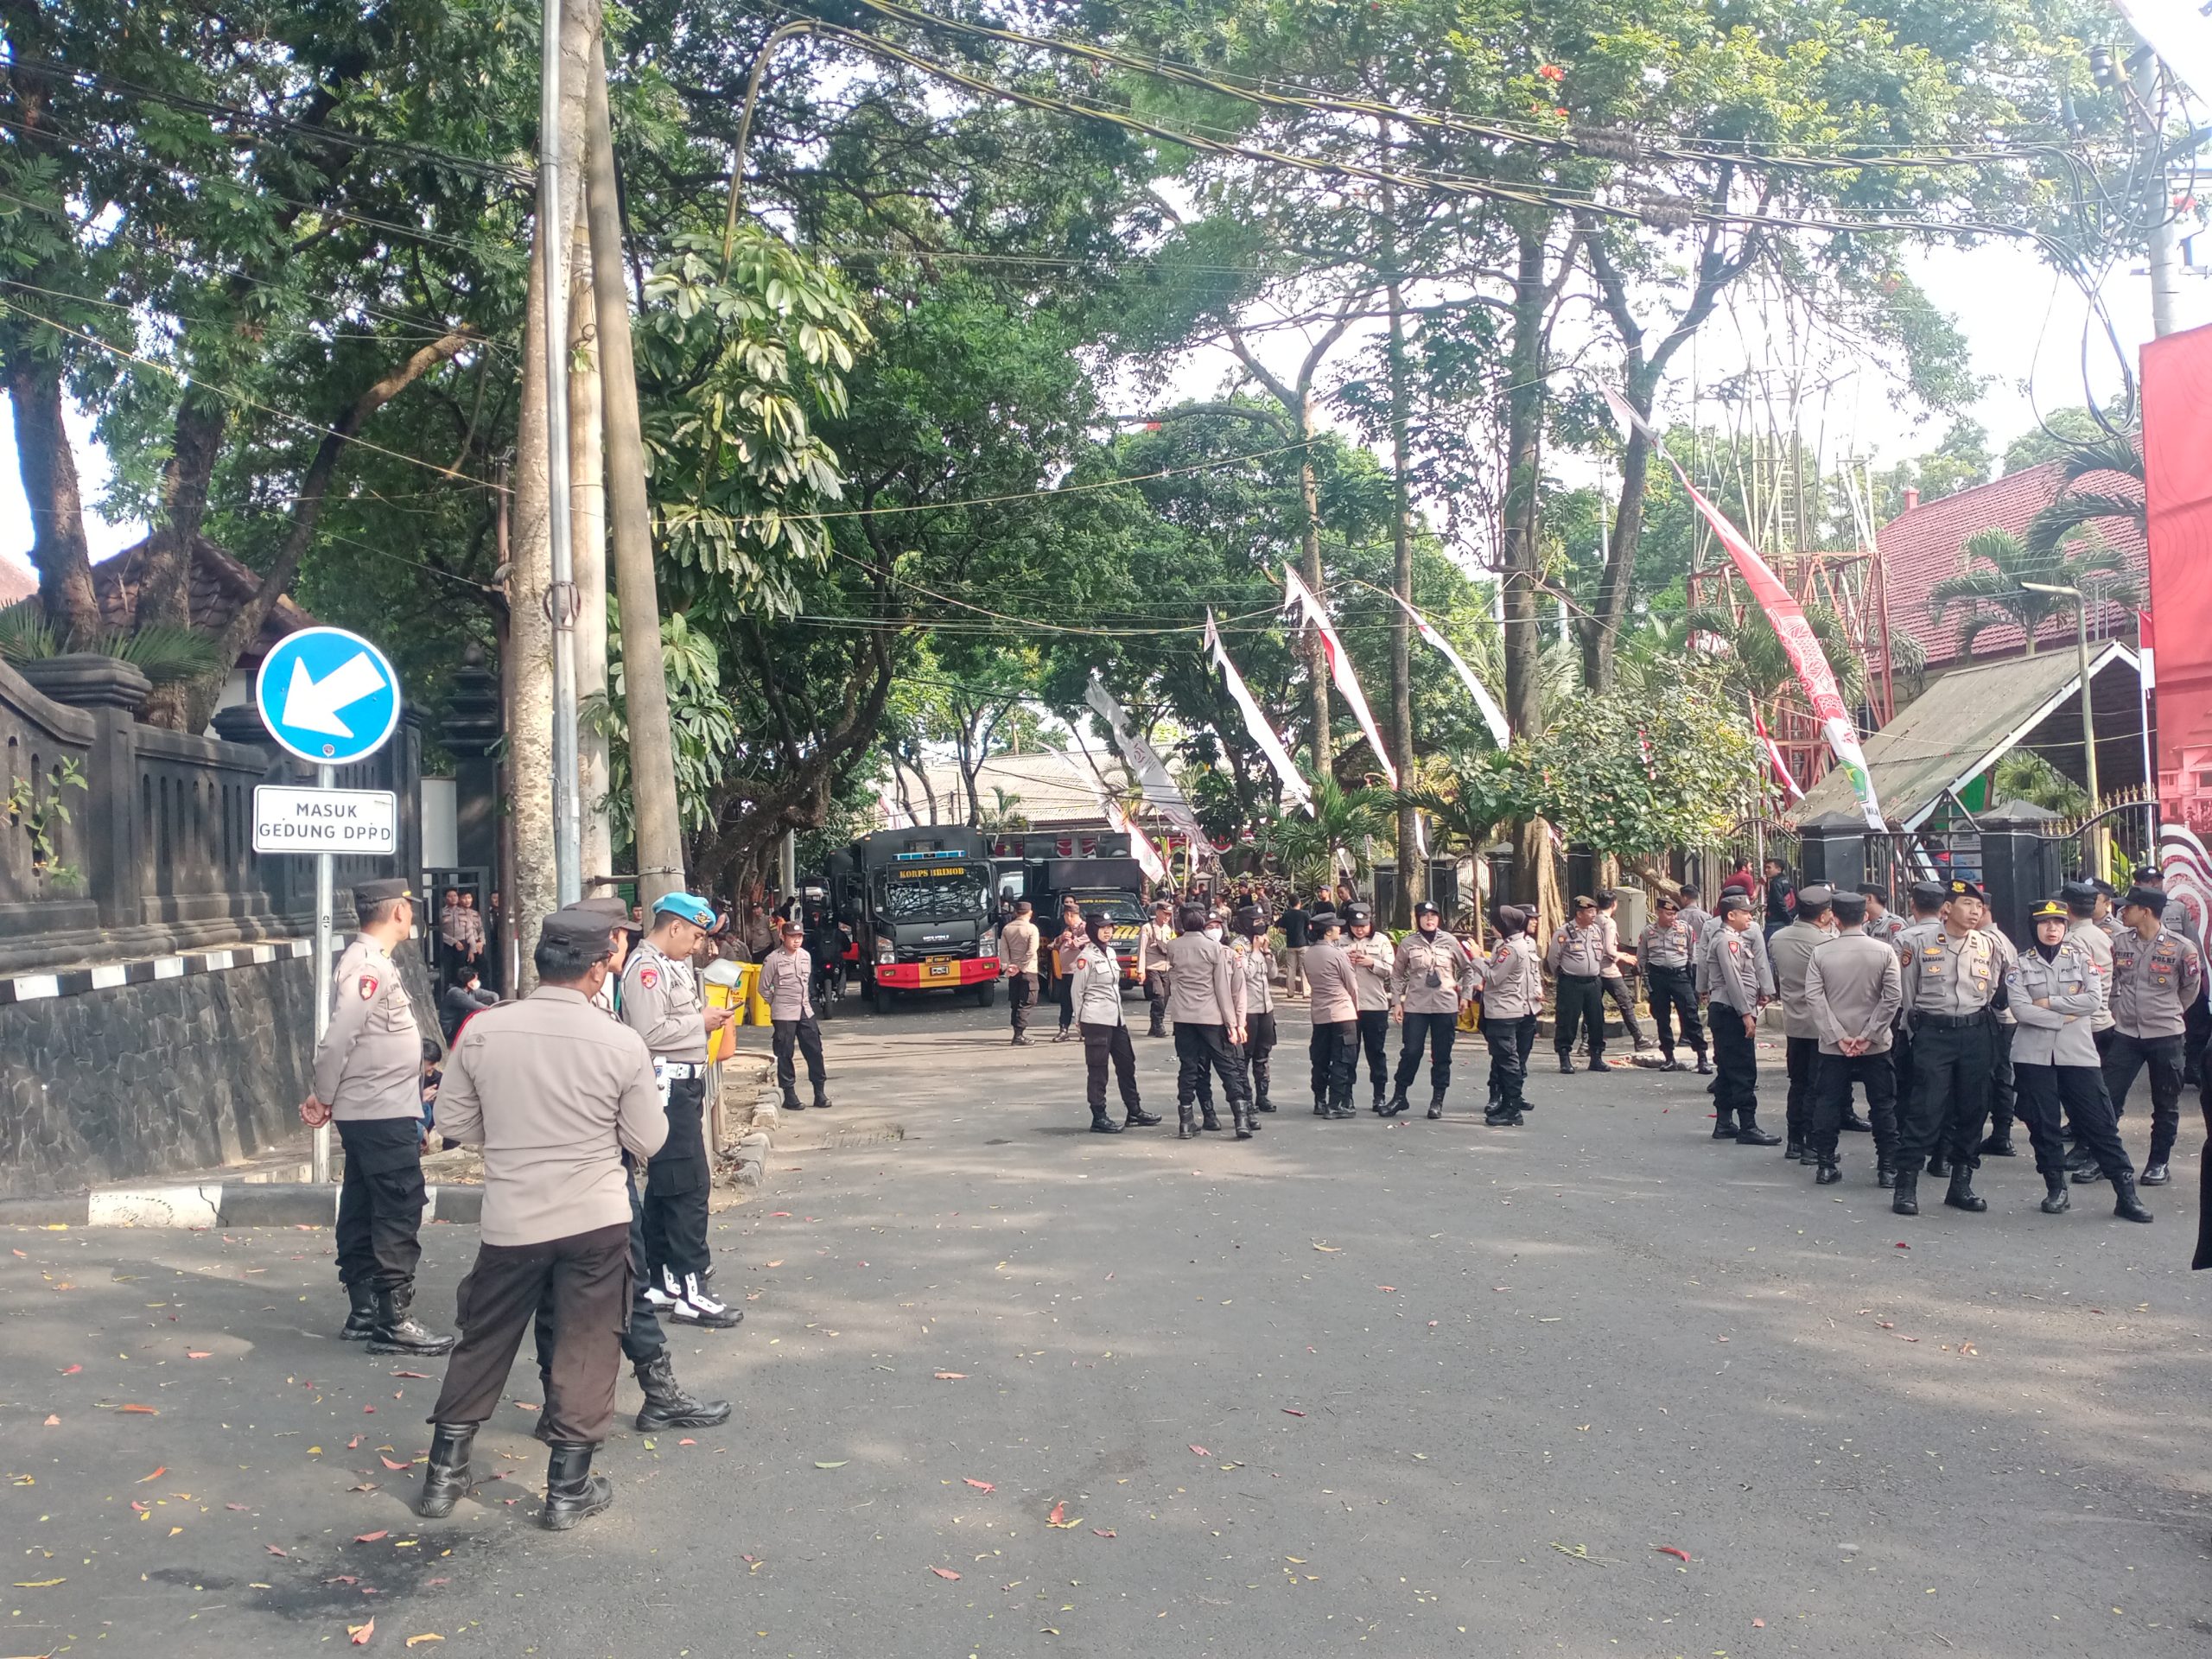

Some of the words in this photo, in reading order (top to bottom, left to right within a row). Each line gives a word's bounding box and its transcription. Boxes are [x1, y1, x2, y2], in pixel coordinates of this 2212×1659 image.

[296, 803, 358, 818] MASUK
[259, 823, 335, 838] GEDUNG
[899, 869, 929, 879] KORPS
[930, 867, 964, 877] BRIMOB
[2152, 956, 2176, 964] POLRI
